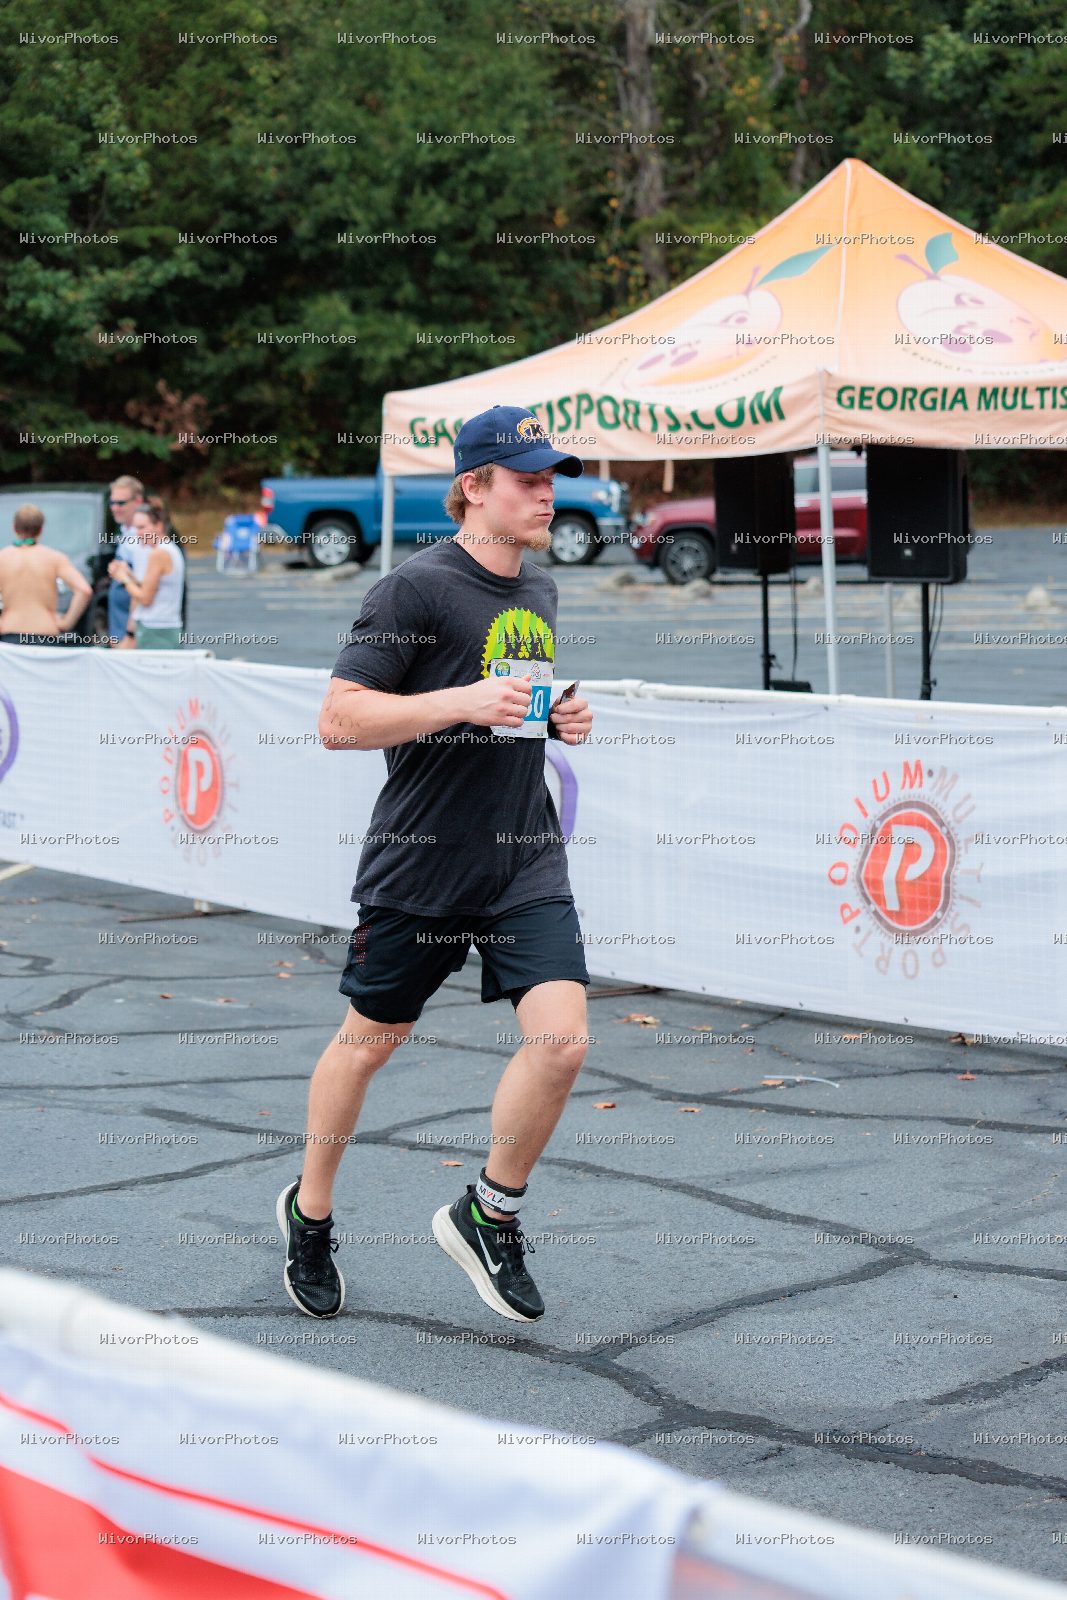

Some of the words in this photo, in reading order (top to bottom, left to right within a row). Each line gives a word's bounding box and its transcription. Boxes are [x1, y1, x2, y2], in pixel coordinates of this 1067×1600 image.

[836, 385, 969, 412] GEORGIA
[826, 758, 924, 925] PODIUM
[883, 825, 936, 912] P
